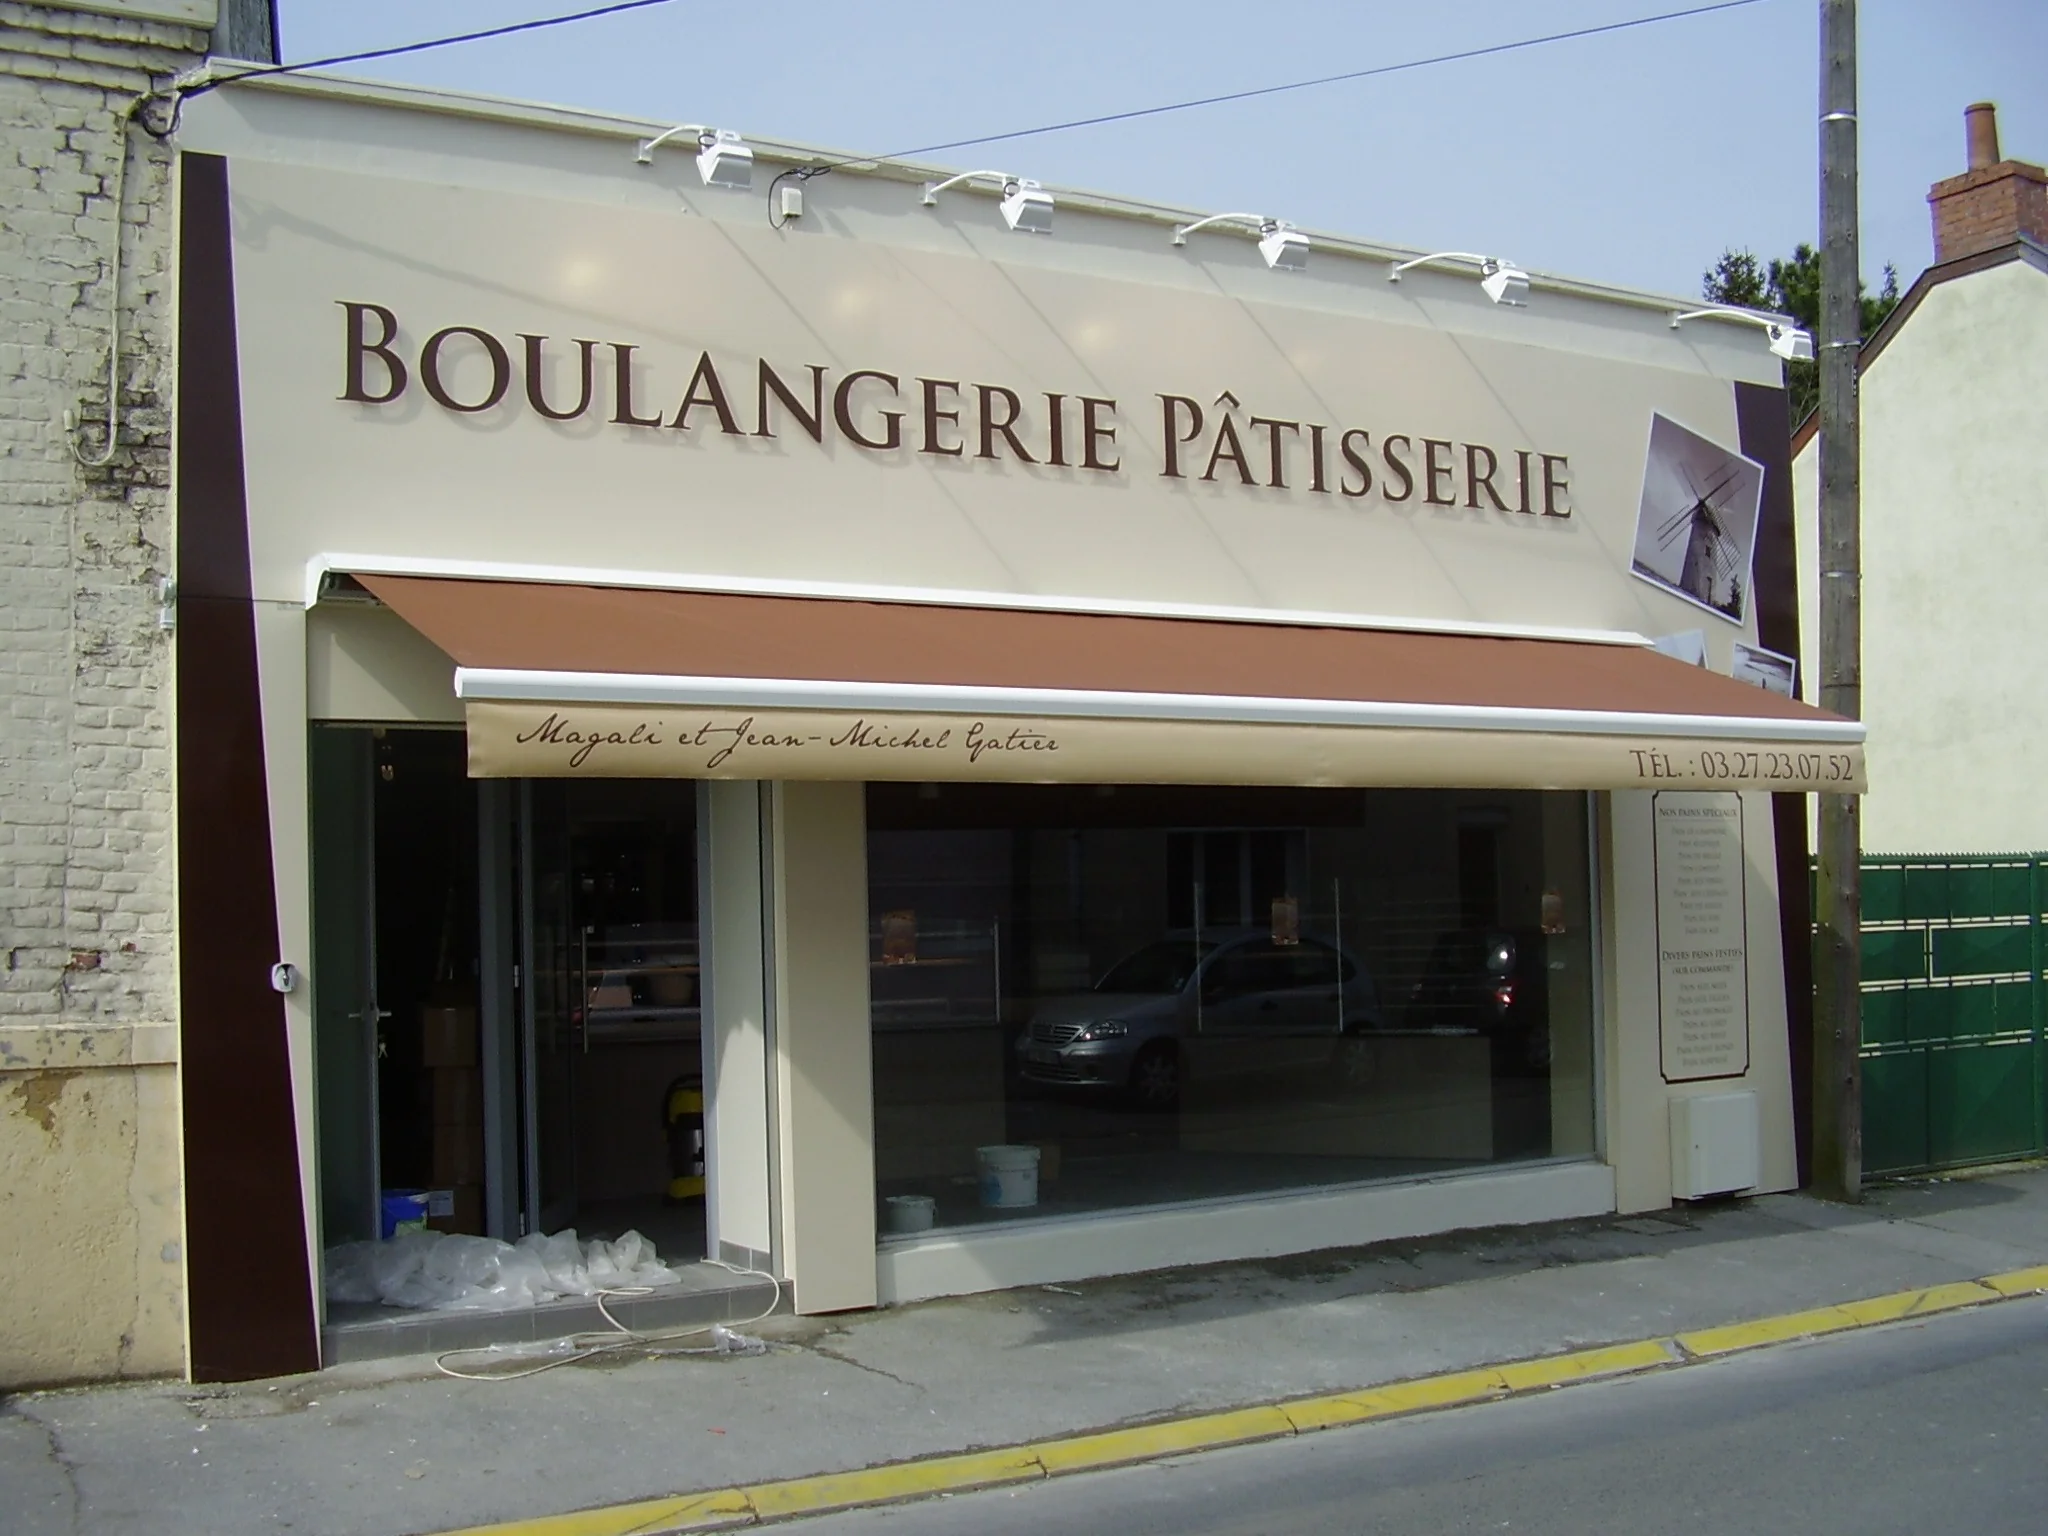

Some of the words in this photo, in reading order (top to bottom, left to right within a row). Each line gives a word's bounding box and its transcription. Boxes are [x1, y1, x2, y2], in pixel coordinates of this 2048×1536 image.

[334, 301, 1121, 471] BOULANGERIE
[1155, 390, 1572, 519] PÂTISSERIE
[516, 712, 663, 768] Magali
[679, 725, 711, 746] et
[707, 717, 949, 769] Jean-Michel
[965, 721, 1060, 764] Gatier
[1629, 747, 1682, 778] TÉL.
[1689, 760, 1695, 776] :
[1701, 751, 1853, 781] 03.27.23.07.52
